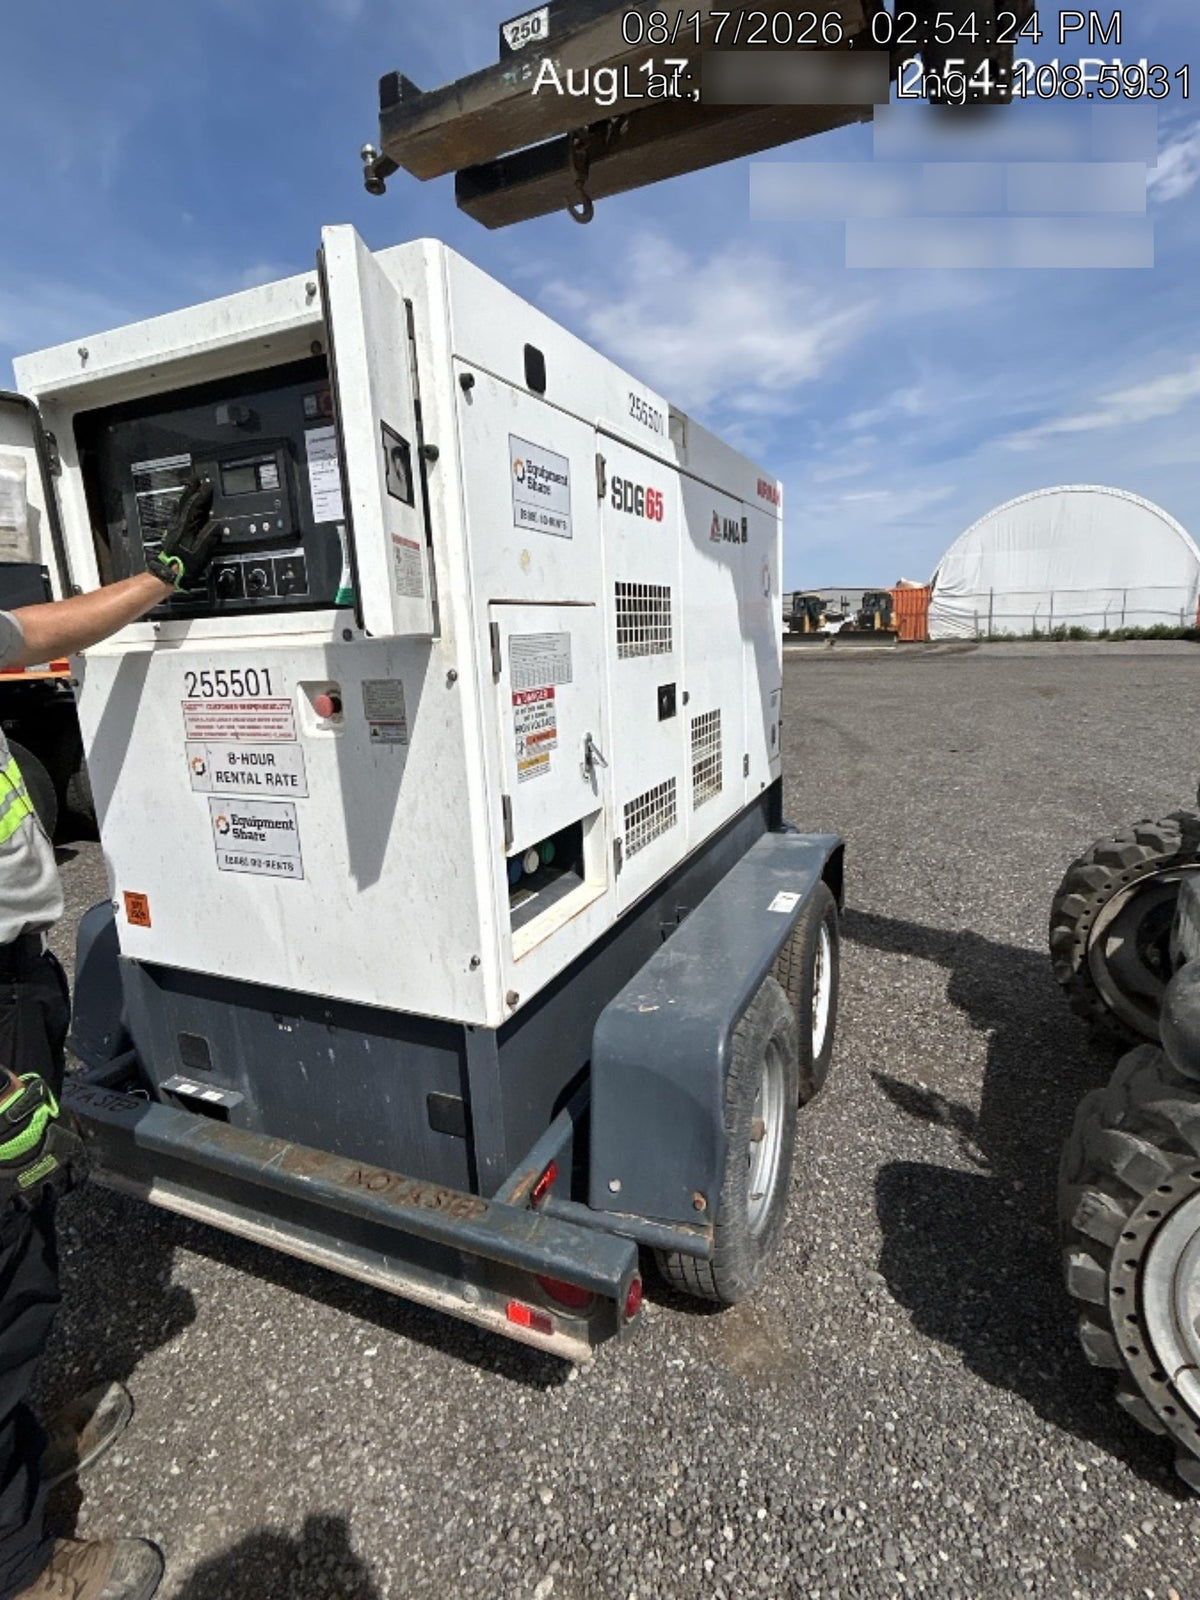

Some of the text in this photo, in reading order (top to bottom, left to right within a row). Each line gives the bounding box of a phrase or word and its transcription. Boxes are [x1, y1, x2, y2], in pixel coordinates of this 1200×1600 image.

[509, 17, 542, 44] 250
[628, 391, 664, 437] 255501
[526, 459, 568, 487] Equipment
[527, 476, 551, 496] Share
[183, 667, 273, 698] 255501
[228, 752, 276, 767] 8-HOUR
[216, 771, 299, 787] RENTAL RATE
[230, 813, 296, 832] Equipment
[232, 828, 267, 842] Share
[347, 1166, 409, 1203] NOT
